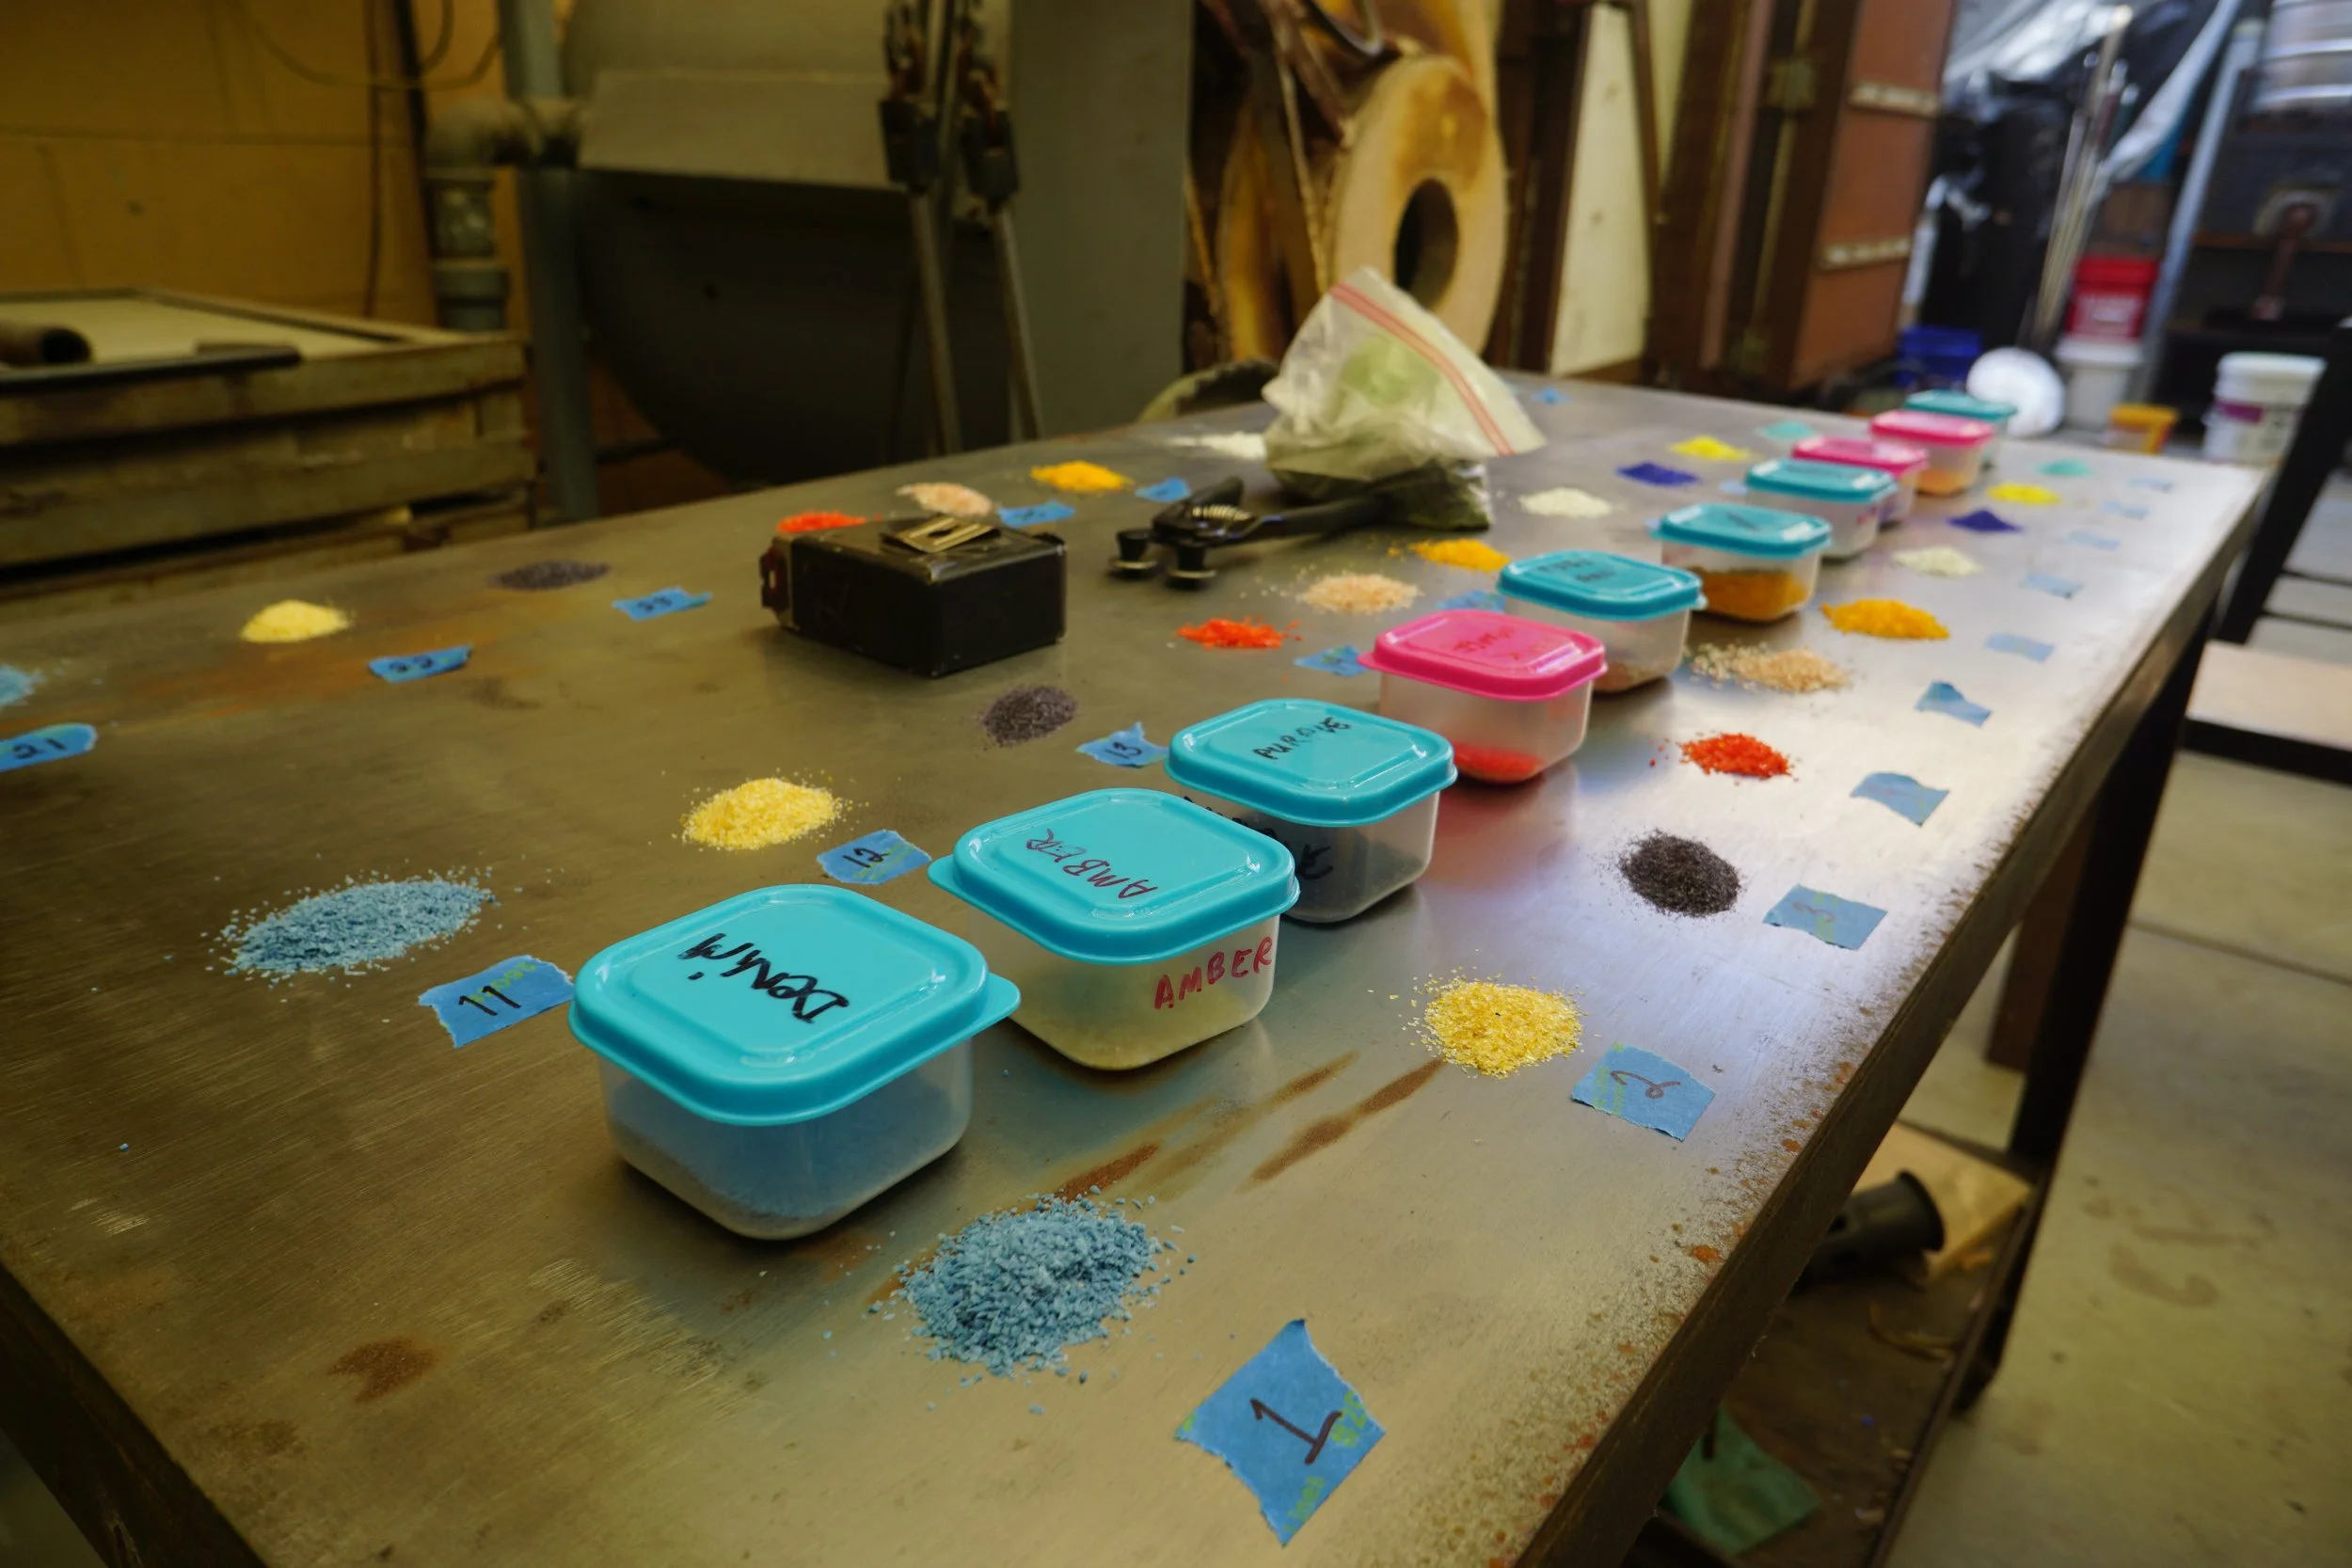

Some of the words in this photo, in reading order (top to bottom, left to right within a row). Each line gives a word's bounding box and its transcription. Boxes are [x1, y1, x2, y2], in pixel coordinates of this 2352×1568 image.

[1104, 741, 1143, 760] 13
[843, 847, 891, 868] 12
[1025, 829, 1158, 899] AMBER
[1153, 936, 1273, 1010] AMBER
[458, 985, 521, 1017] 11
[1610, 1069, 1681, 1100] 2
[1249, 1398, 1343, 1465] 1
